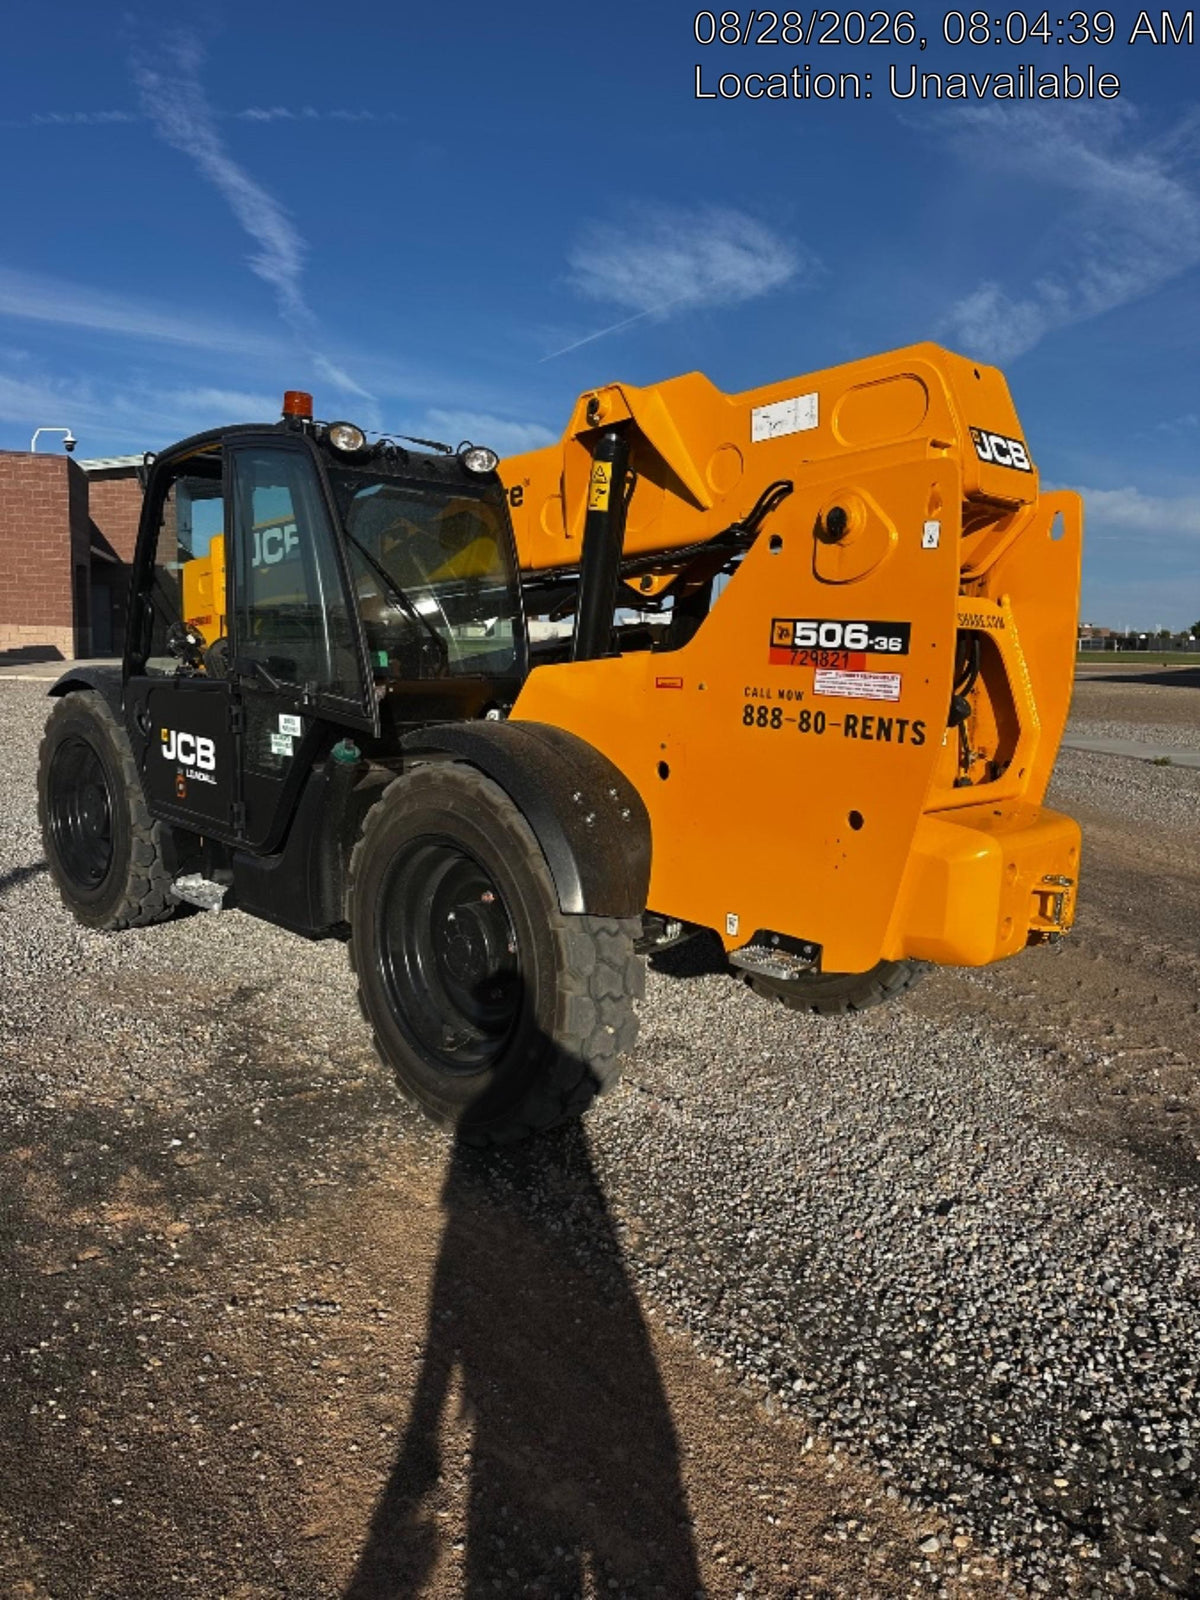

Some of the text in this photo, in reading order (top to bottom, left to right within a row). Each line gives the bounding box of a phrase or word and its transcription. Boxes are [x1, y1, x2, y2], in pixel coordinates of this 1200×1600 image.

[976, 432, 1030, 470] JCB
[789, 649, 850, 669] 729821
[744, 686, 772, 699] CALL
[778, 689, 804, 701] NOW
[742, 703, 926, 746] 888-80-RENTS
[161, 729, 216, 771] JCB
